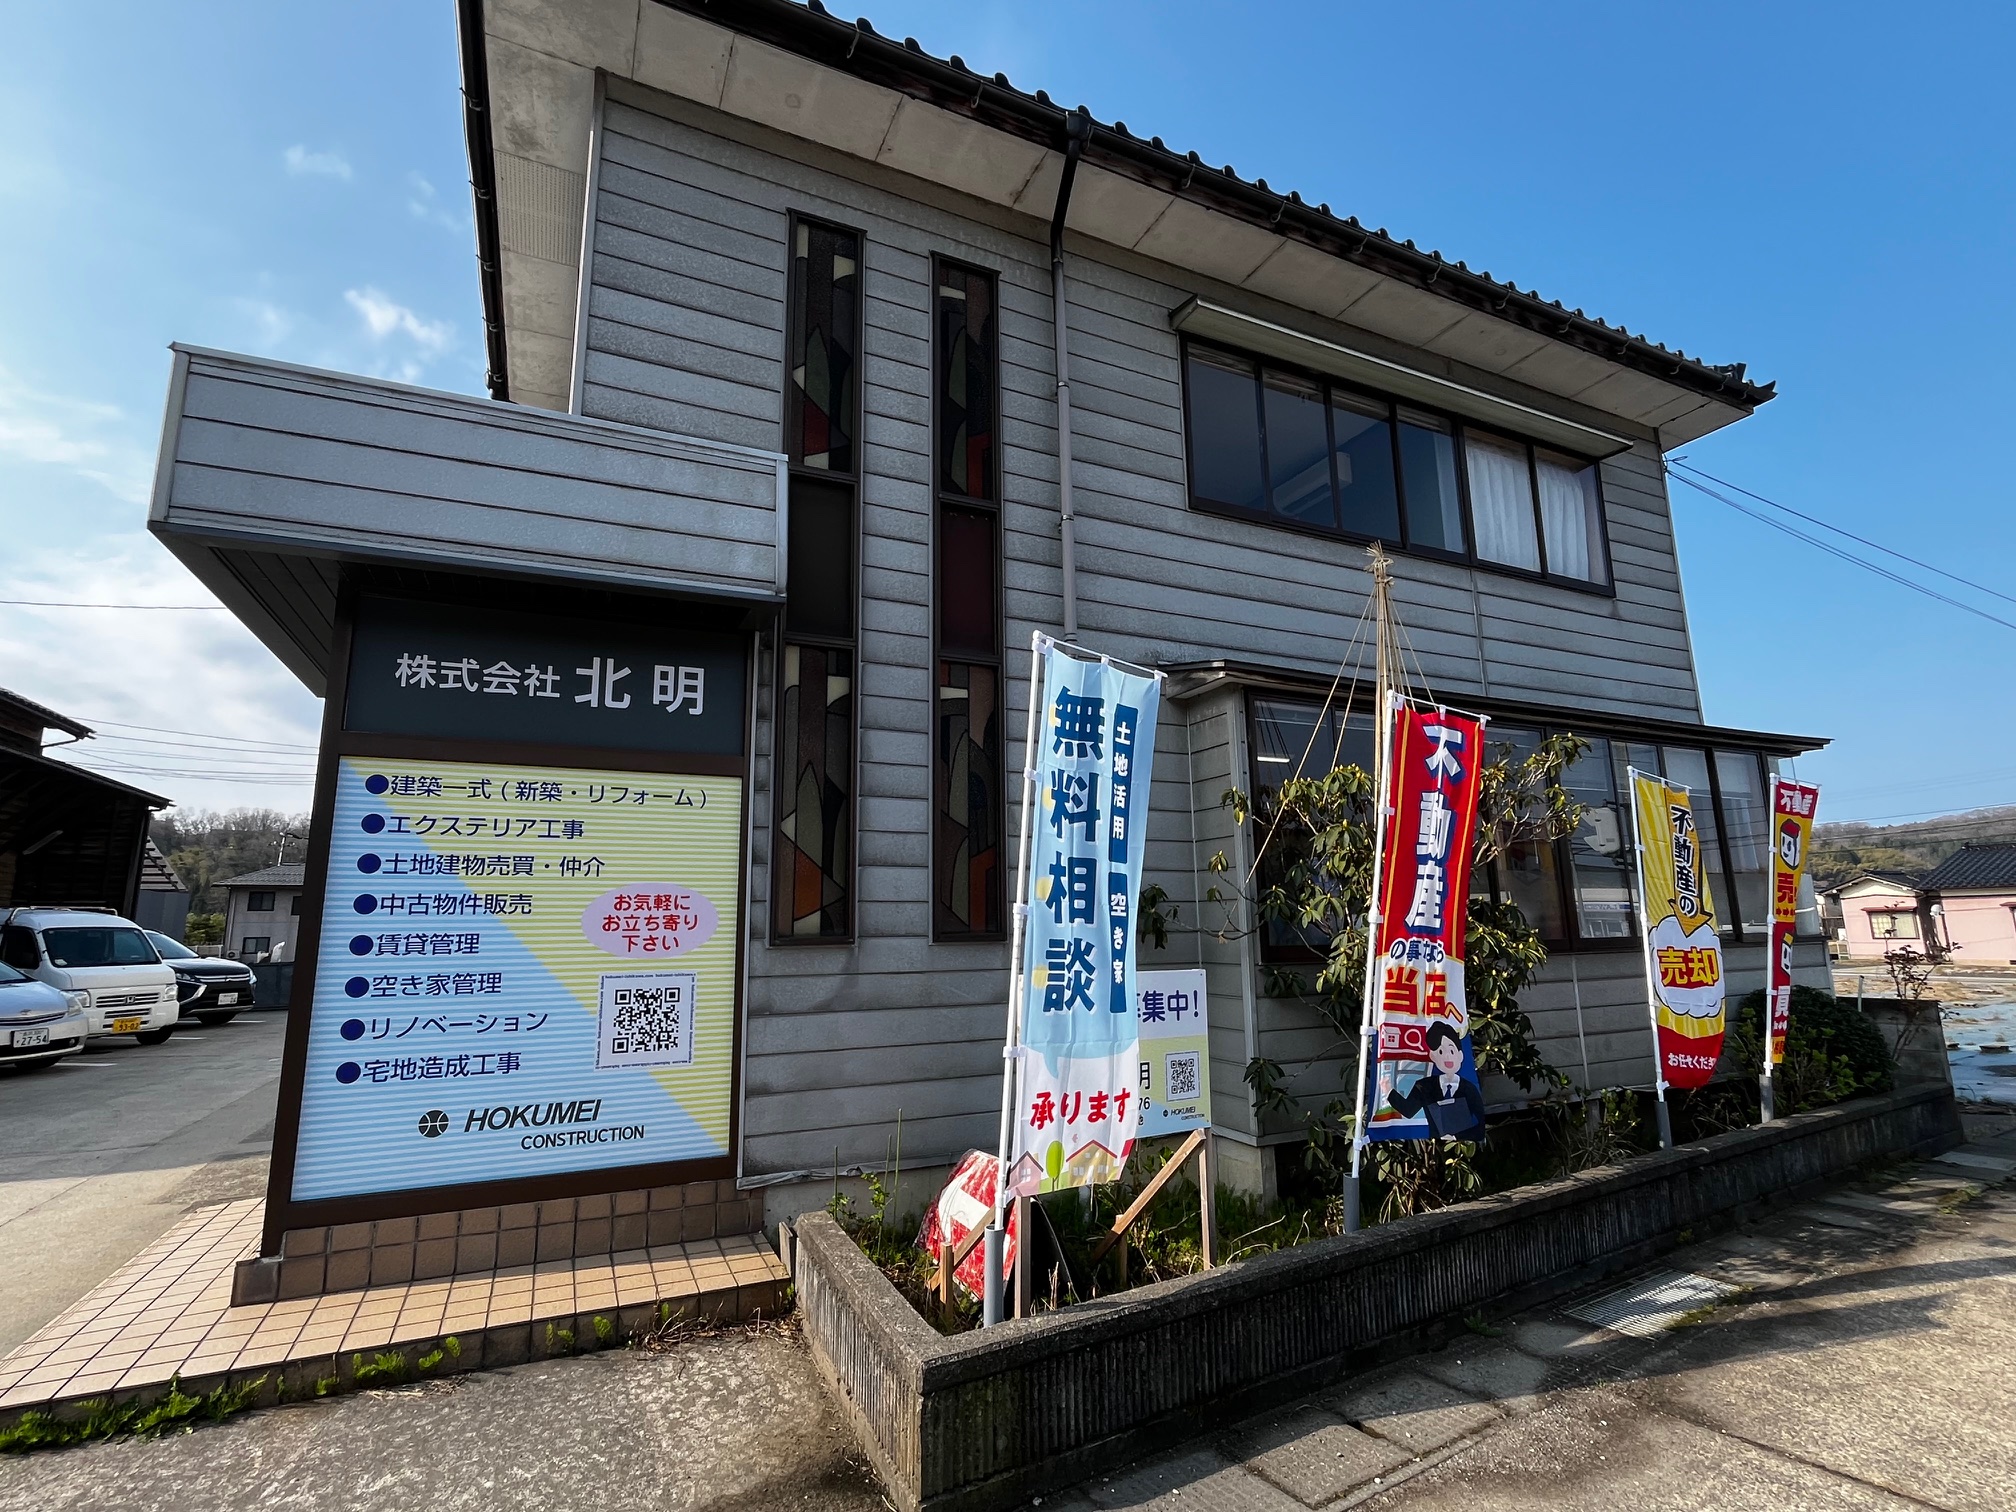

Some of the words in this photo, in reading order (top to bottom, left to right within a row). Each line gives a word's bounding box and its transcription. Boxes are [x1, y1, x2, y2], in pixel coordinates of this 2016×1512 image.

[394, 652, 561, 699] 株式会社
[1112, 721, 1131, 841] 土地活用
[386, 813, 585, 840] エクステリア工事
[1404, 724, 1465, 930] 不動産
[1042, 685, 1106, 1013] 無料相談
[1671, 805, 1698, 917] 不動産の
[381, 853, 606, 878] 土地建物売買・仲介
[379, 893, 533, 916] 中古物件販売
[612, 893, 691, 912] お気軽に
[601, 914, 699, 933] お立ち寄り
[375, 932, 481, 957] 賃貸管理
[621, 933, 680, 953] 下さい
[1110, 892, 1128, 985] 空き家
[1390, 939, 1445, 964] の事なら
[1658, 946, 1719, 986] 売却
[370, 972, 503, 998] 空き家管理
[1383, 965, 1464, 1024] 当店へ
[370, 1012, 549, 1041] リノベーション
[362, 1052, 522, 1085] 宅地造成工事
[463, 1099, 603, 1133] HOKUMEI
[1029, 1087, 1132, 1131] 承ります
[1170, 1106, 1196, 1116] HOKUMEI
[520, 1125, 646, 1151] CONSTRUCTION
